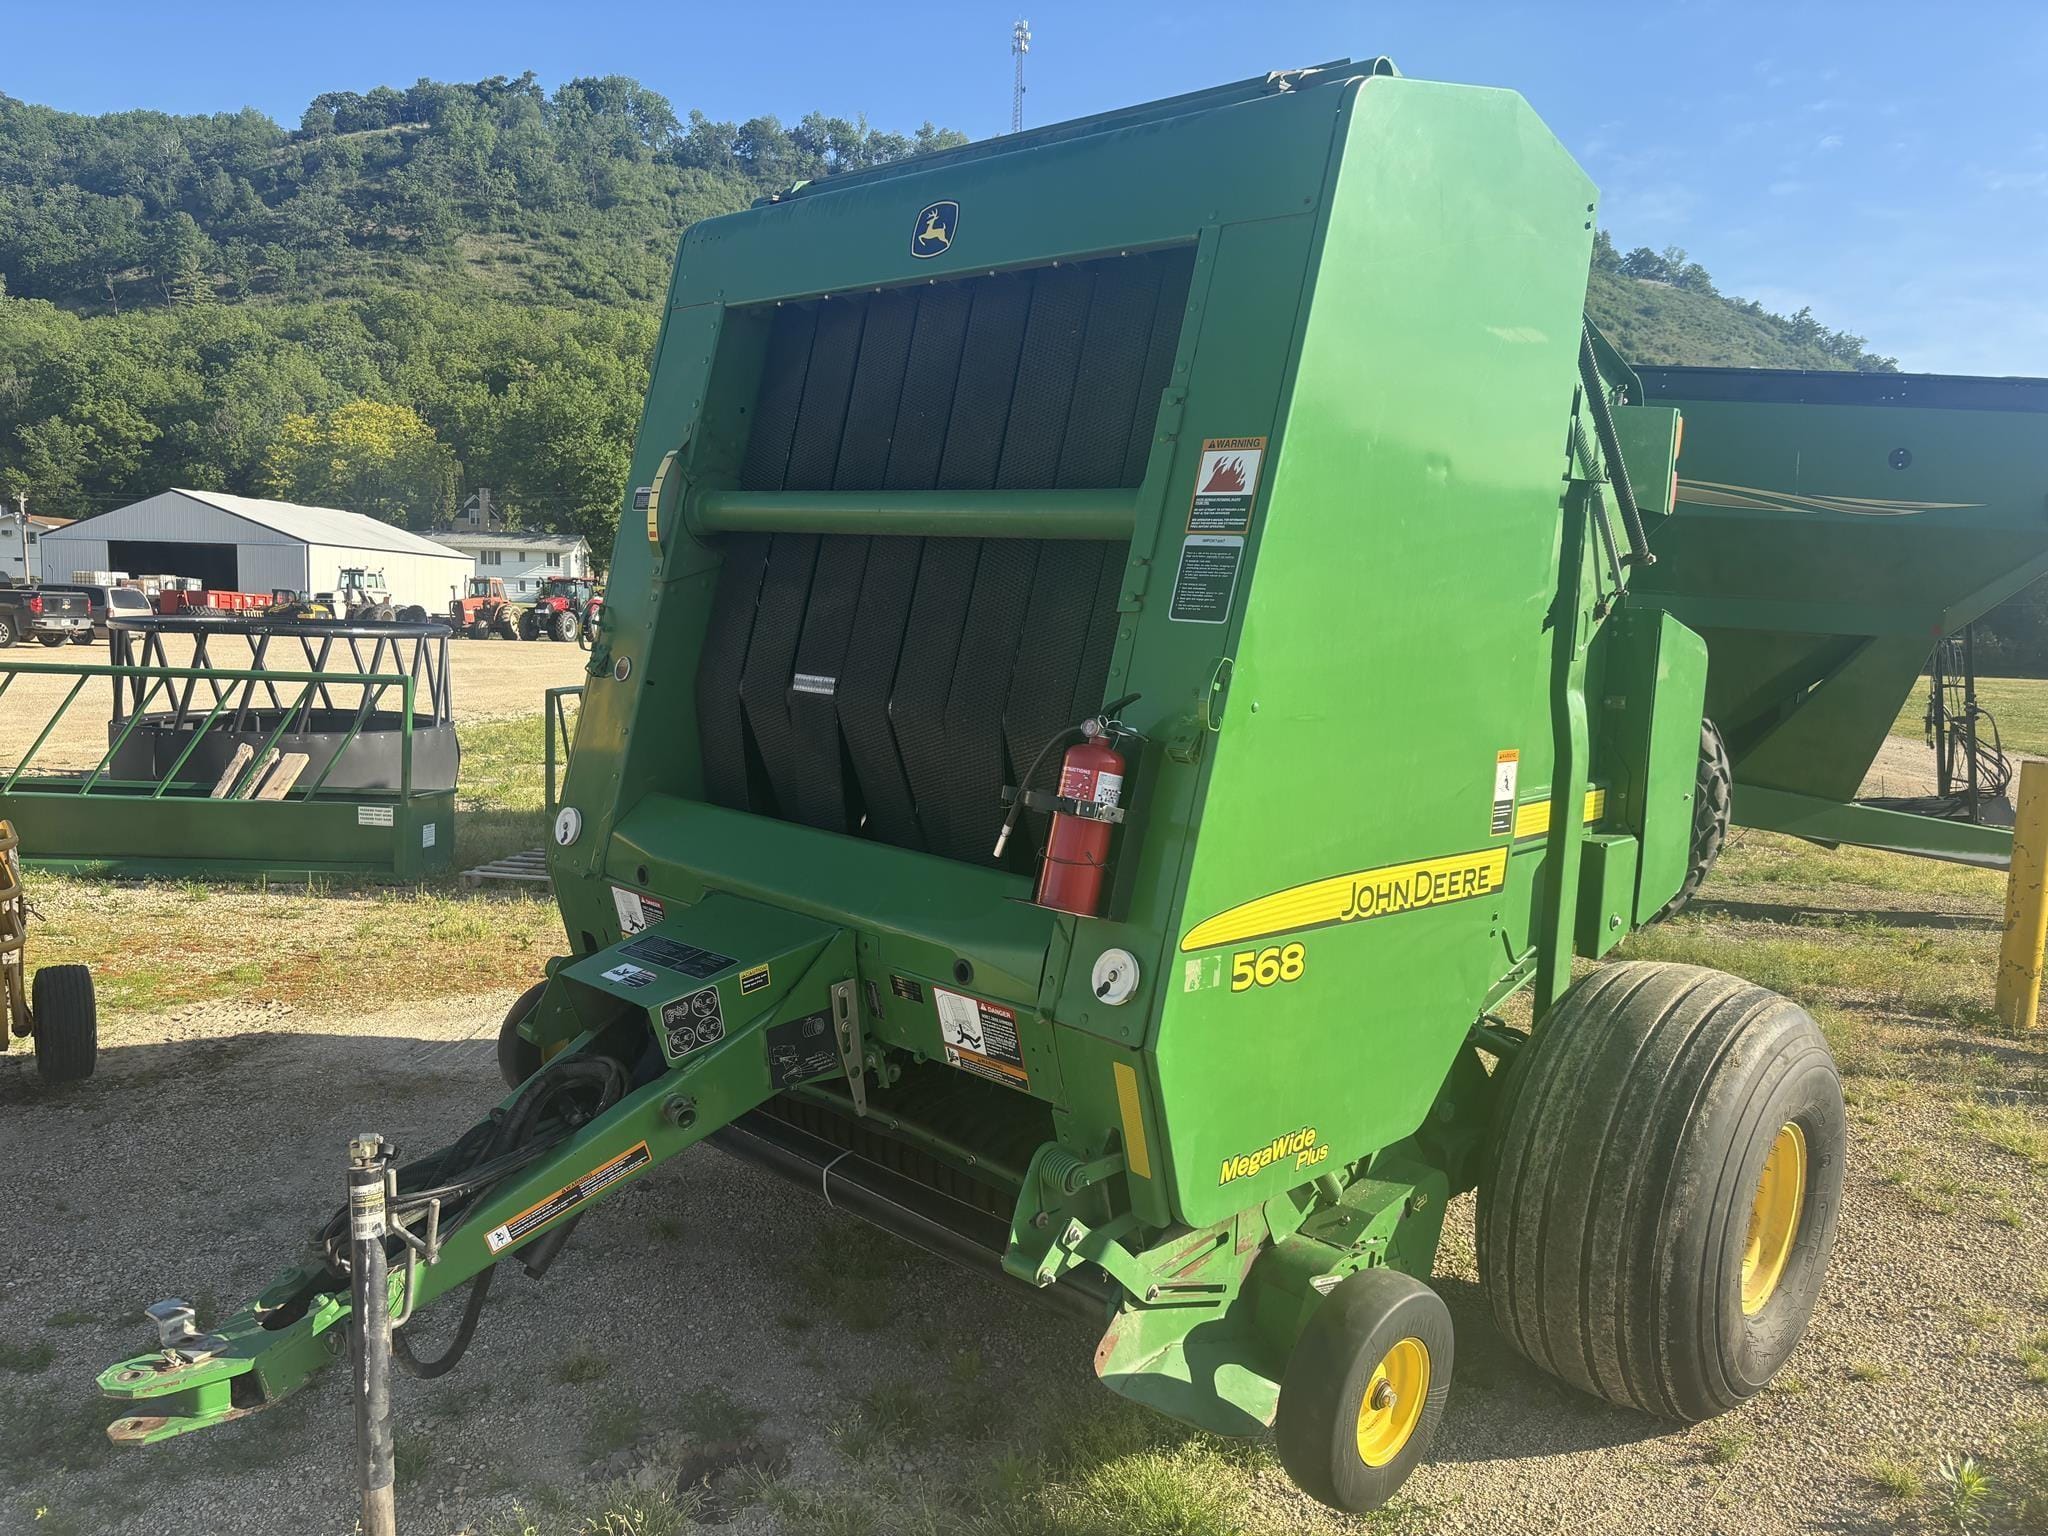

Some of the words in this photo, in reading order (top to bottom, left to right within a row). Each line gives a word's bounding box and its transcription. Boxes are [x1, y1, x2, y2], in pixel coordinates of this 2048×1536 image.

[1216, 438, 1260, 449] WARNING
[1341, 881, 1410, 916] JOHN
[1414, 865, 1491, 902] DEERE
[1230, 940, 1306, 993] 568
[987, 1006, 1011, 1019] DANGER
[1219, 1126, 1316, 1186] MegaWide
[1295, 1143, 1329, 1172] Plus
